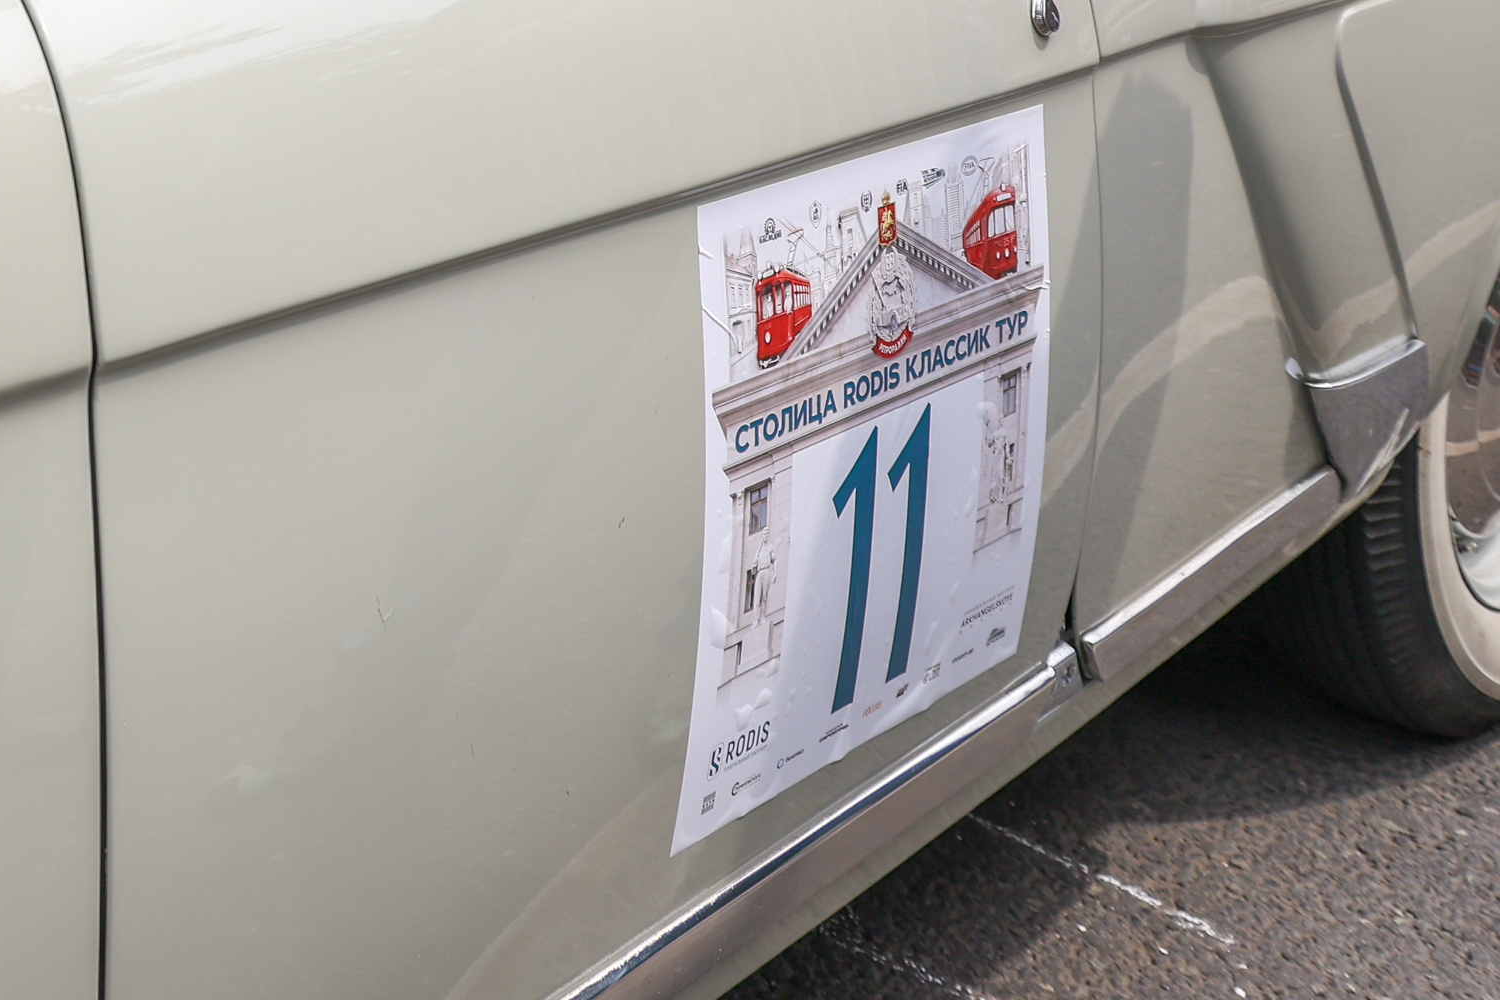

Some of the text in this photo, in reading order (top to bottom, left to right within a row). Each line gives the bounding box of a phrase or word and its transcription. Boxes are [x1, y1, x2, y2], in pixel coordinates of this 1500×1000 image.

[734, 309, 1030, 454] СТОЛИЦА RODIS КЛАССИК ТУР
[831, 403, 932, 715] 11
[725, 720, 771, 764] RODIS
